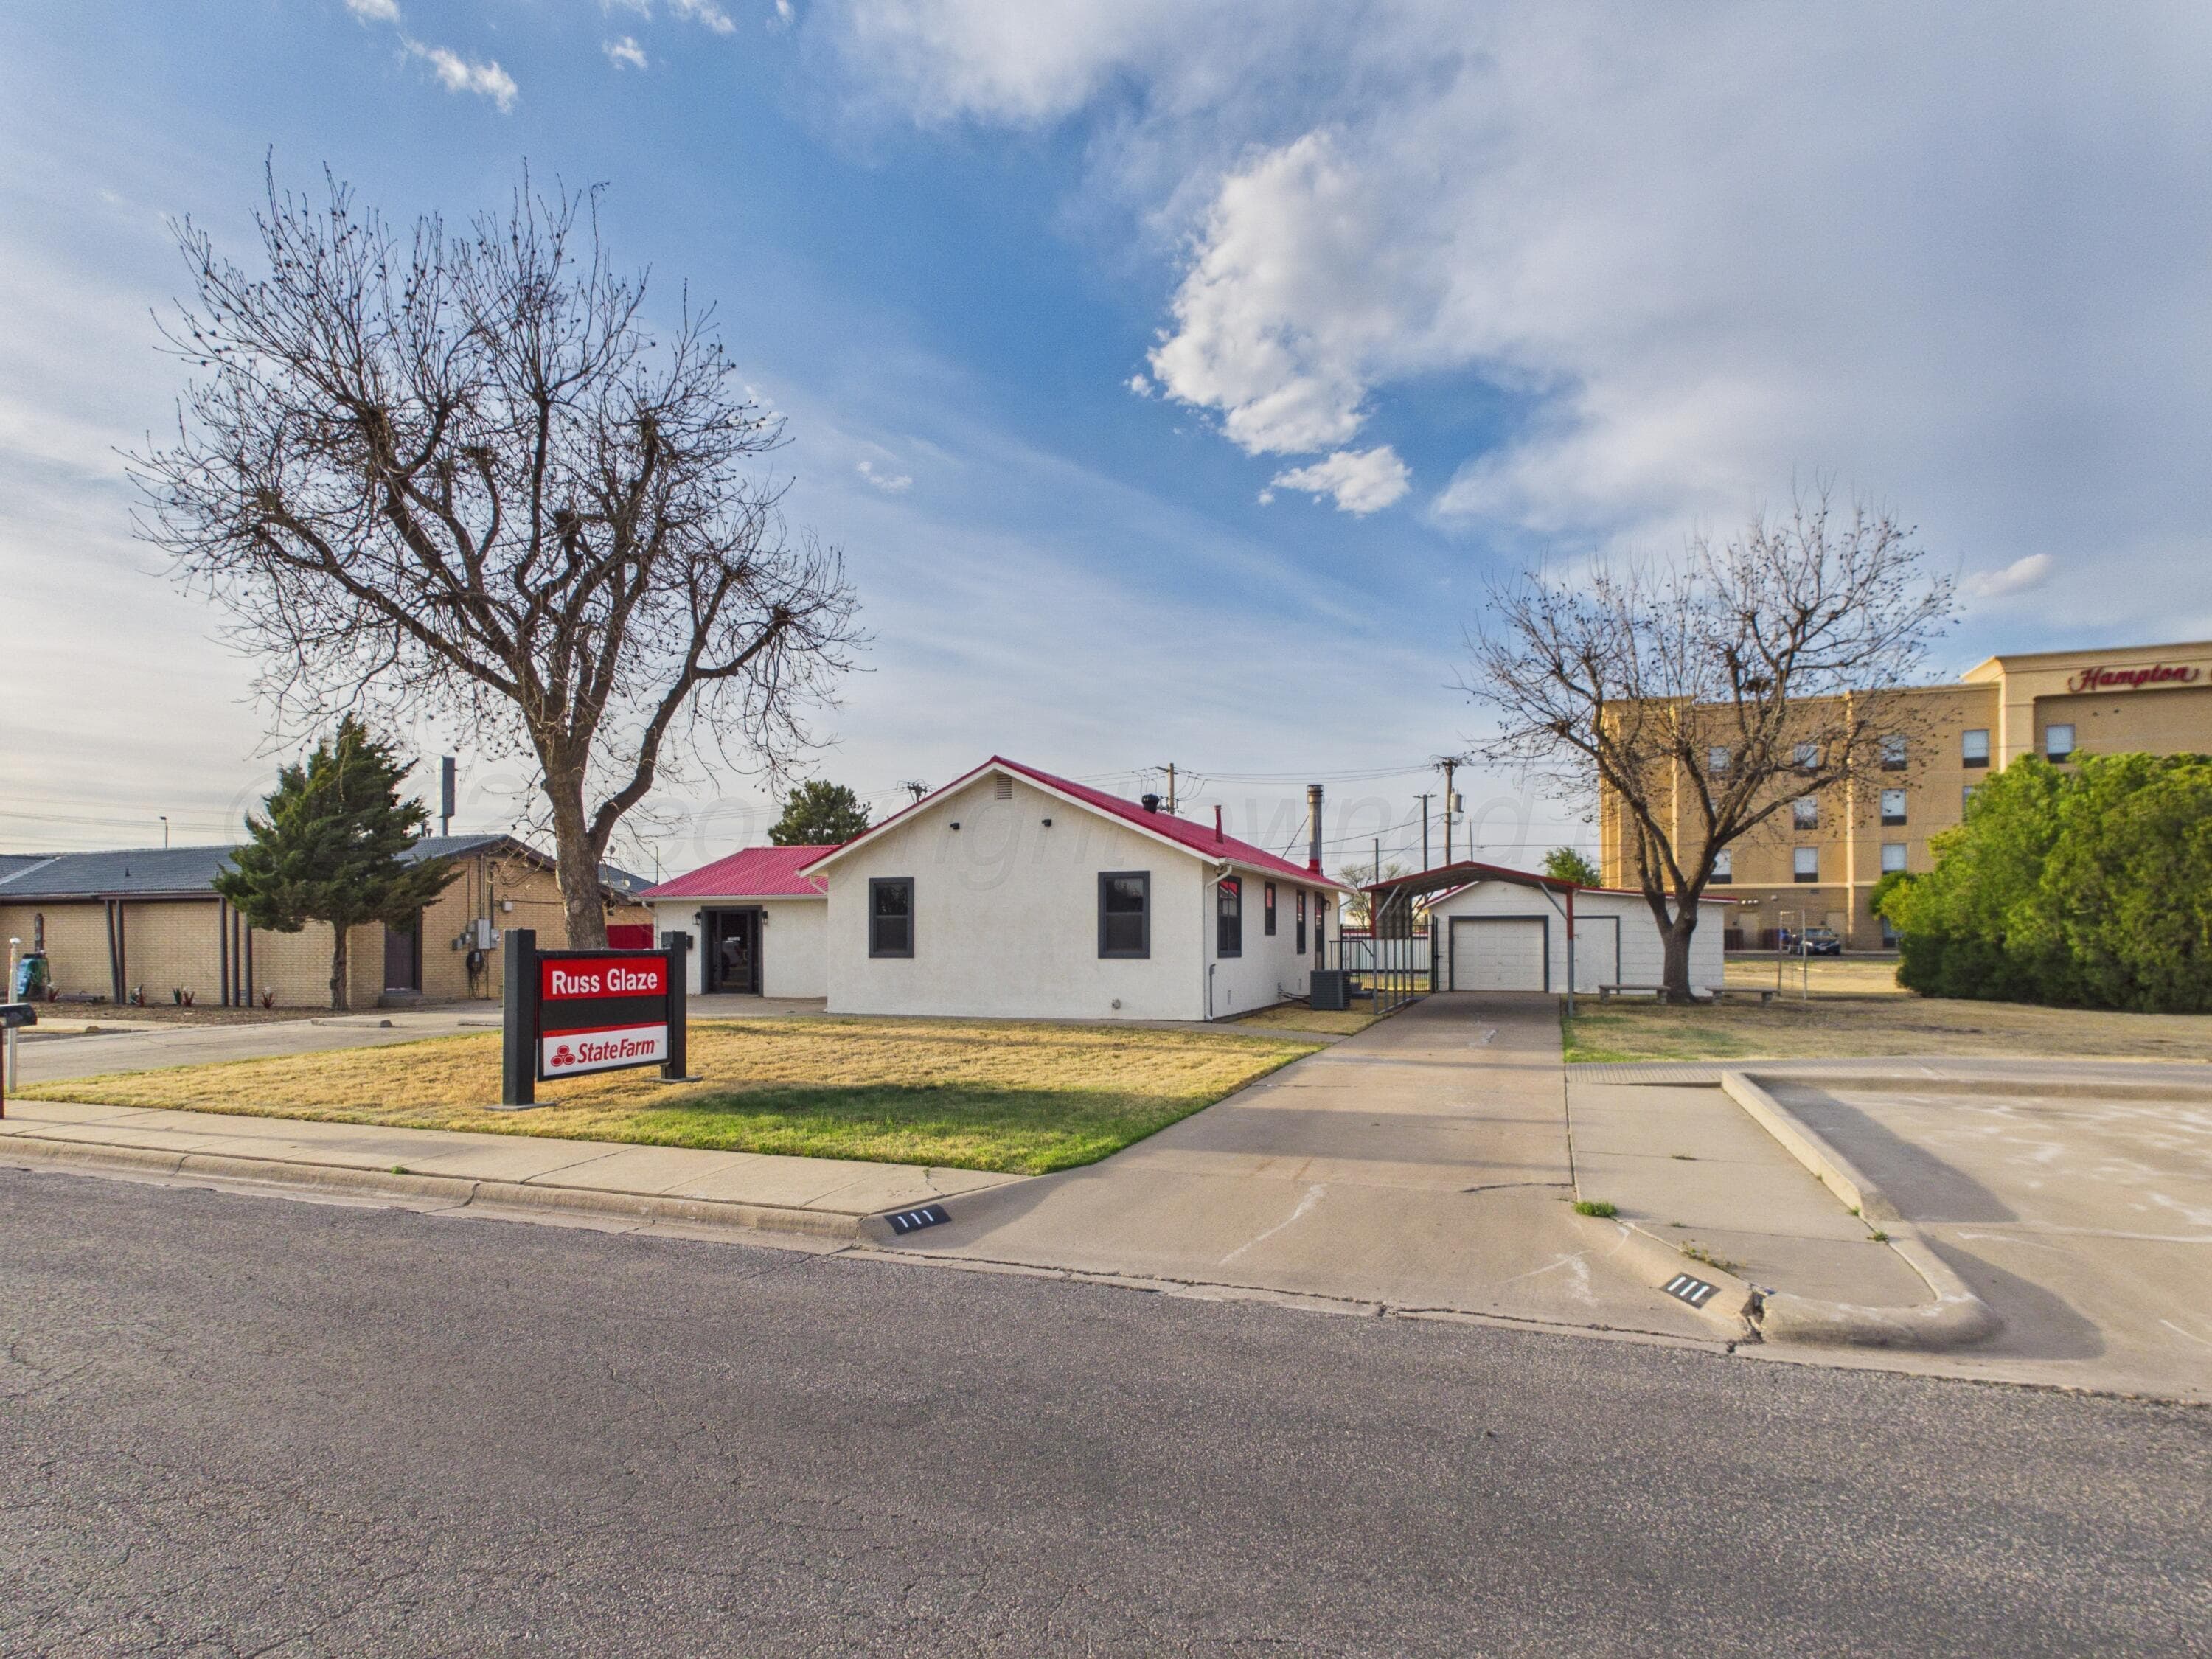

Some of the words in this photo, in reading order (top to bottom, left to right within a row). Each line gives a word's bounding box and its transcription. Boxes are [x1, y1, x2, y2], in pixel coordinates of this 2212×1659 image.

[2068, 664, 2201, 692] Hampton
[552, 970, 600, 995] Russ
[607, 968, 658, 992] Glaze
[897, 1210, 934, 1228] 111
[1667, 1276, 1710, 1301] 111
